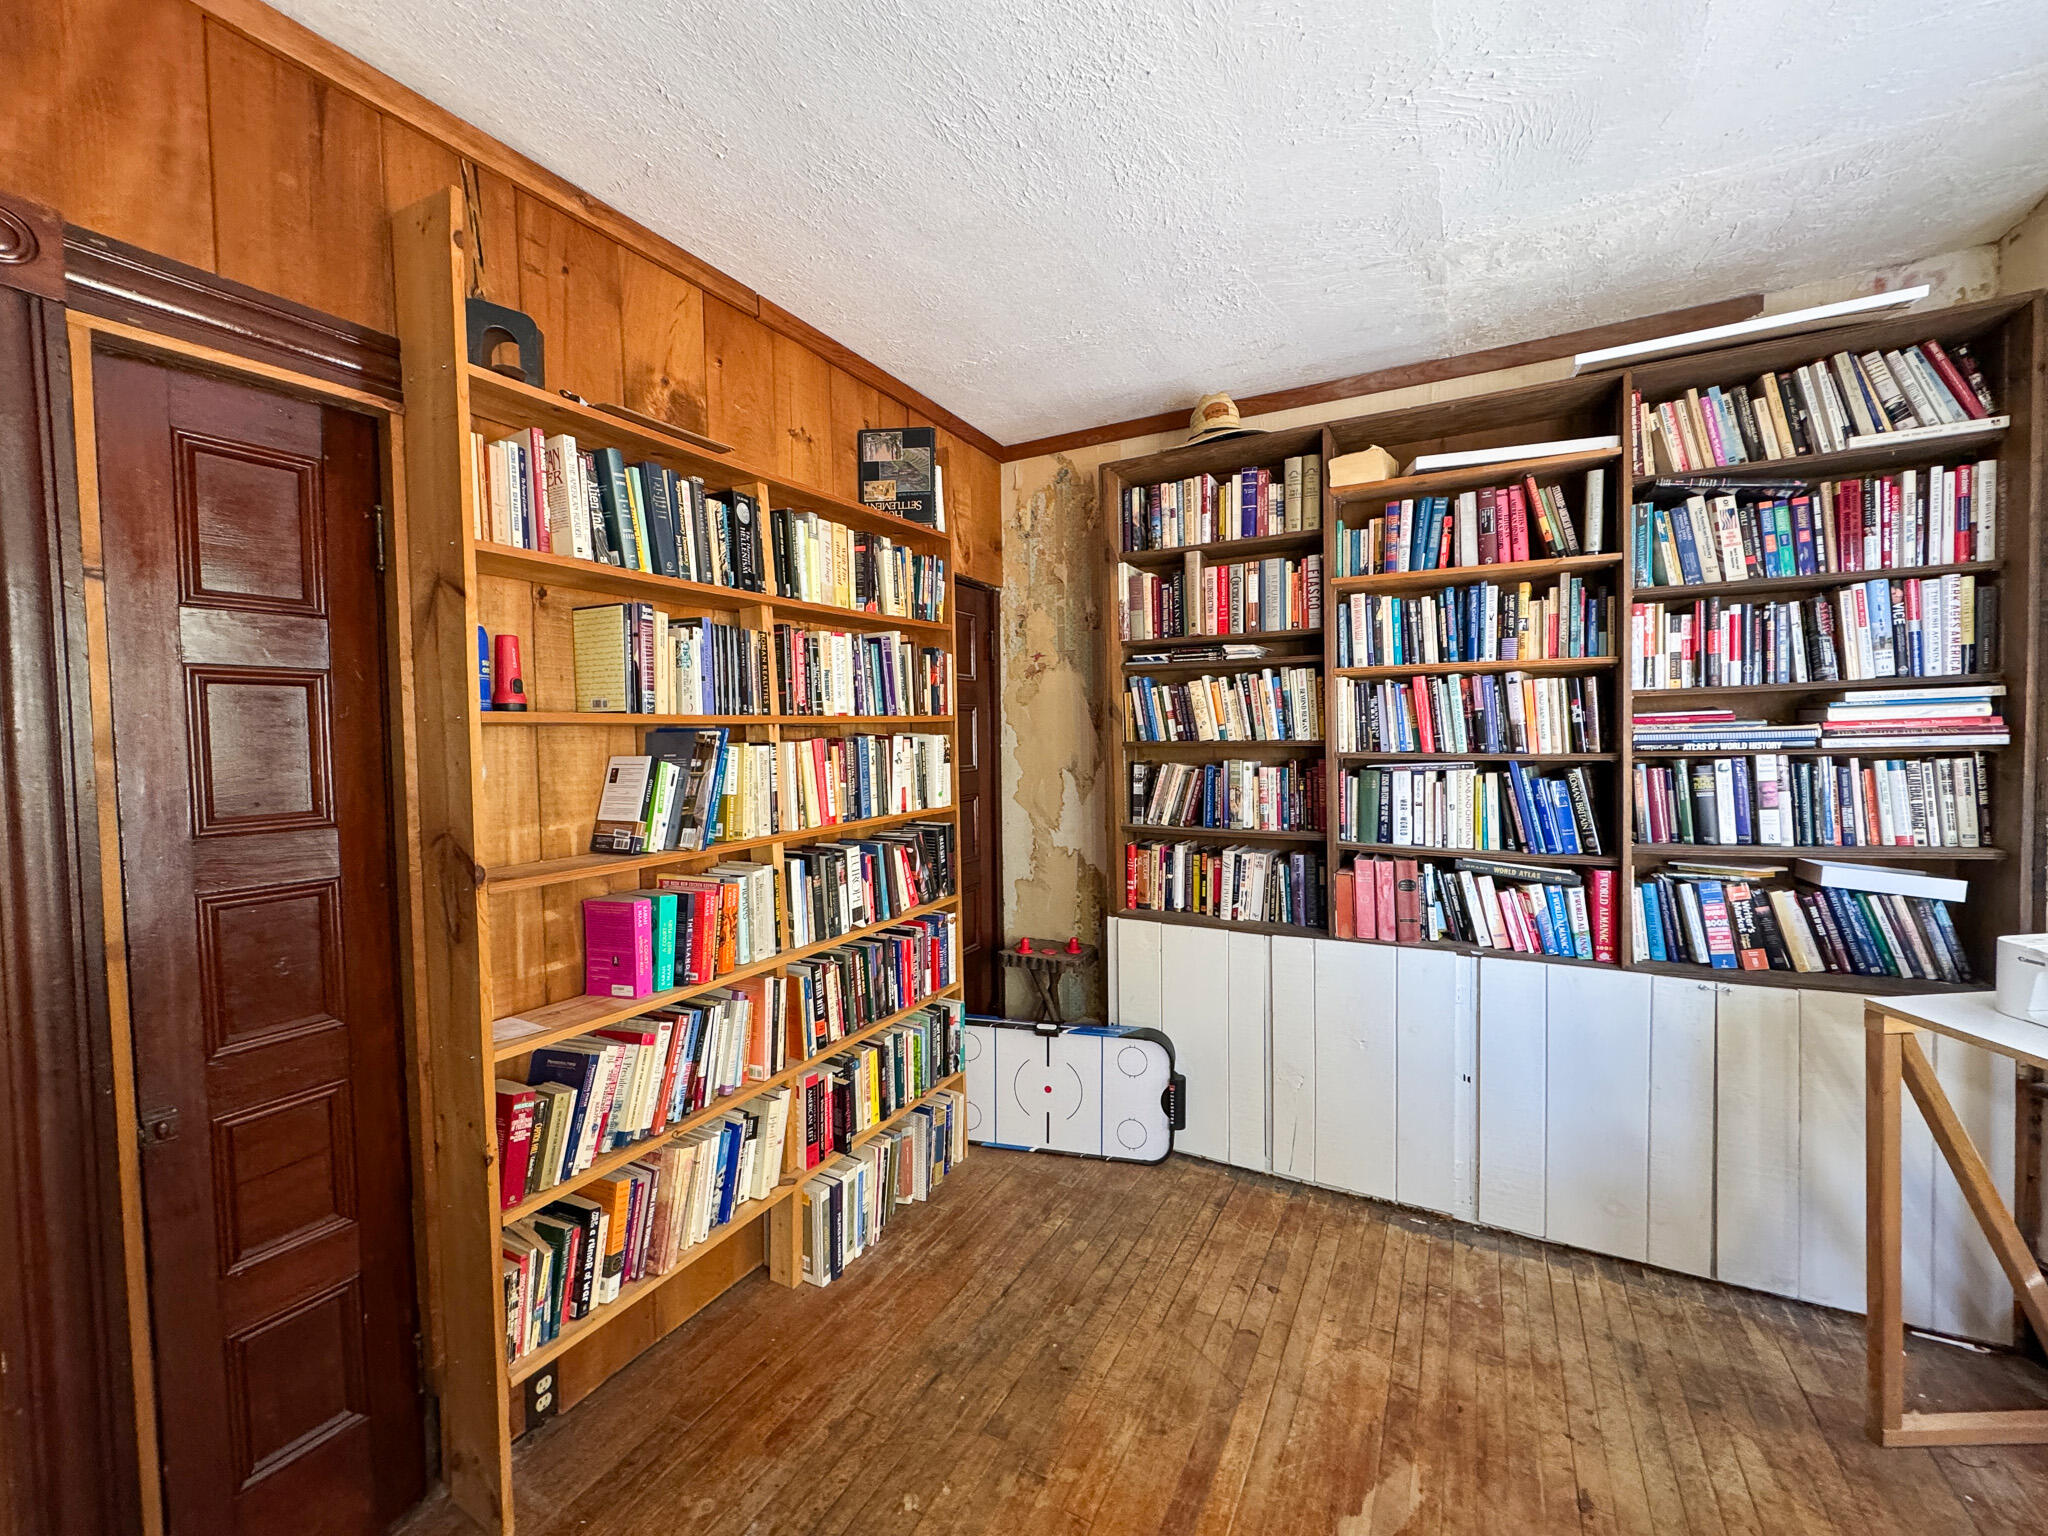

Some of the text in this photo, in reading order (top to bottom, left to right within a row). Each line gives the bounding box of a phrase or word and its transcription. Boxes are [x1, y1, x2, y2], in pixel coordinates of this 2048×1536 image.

[570, 477, 580, 510] AMERICAN
[587, 480, 604, 530] Alien Ink
[1307, 569, 1320, 610] FIASCO
[1892, 602, 1905, 625] VICE
[1950, 603, 1961, 629] AGES
[1949, 630, 1961, 672] AMERICA
[1568, 773, 1590, 830] ROMAN BRITAIN
[1907, 763, 1924, 829] COLLATERAL DAMAGE
[850, 854, 861, 907] EUROPE
[1550, 898, 1568, 950] WORLD ALMANAC
[1732, 902, 1746, 933] Market
[1741, 900, 1757, 934] Writer's
[1826, 891, 1840, 918] WRITING
[1572, 898, 1587, 954] WORLD ALMANAC
